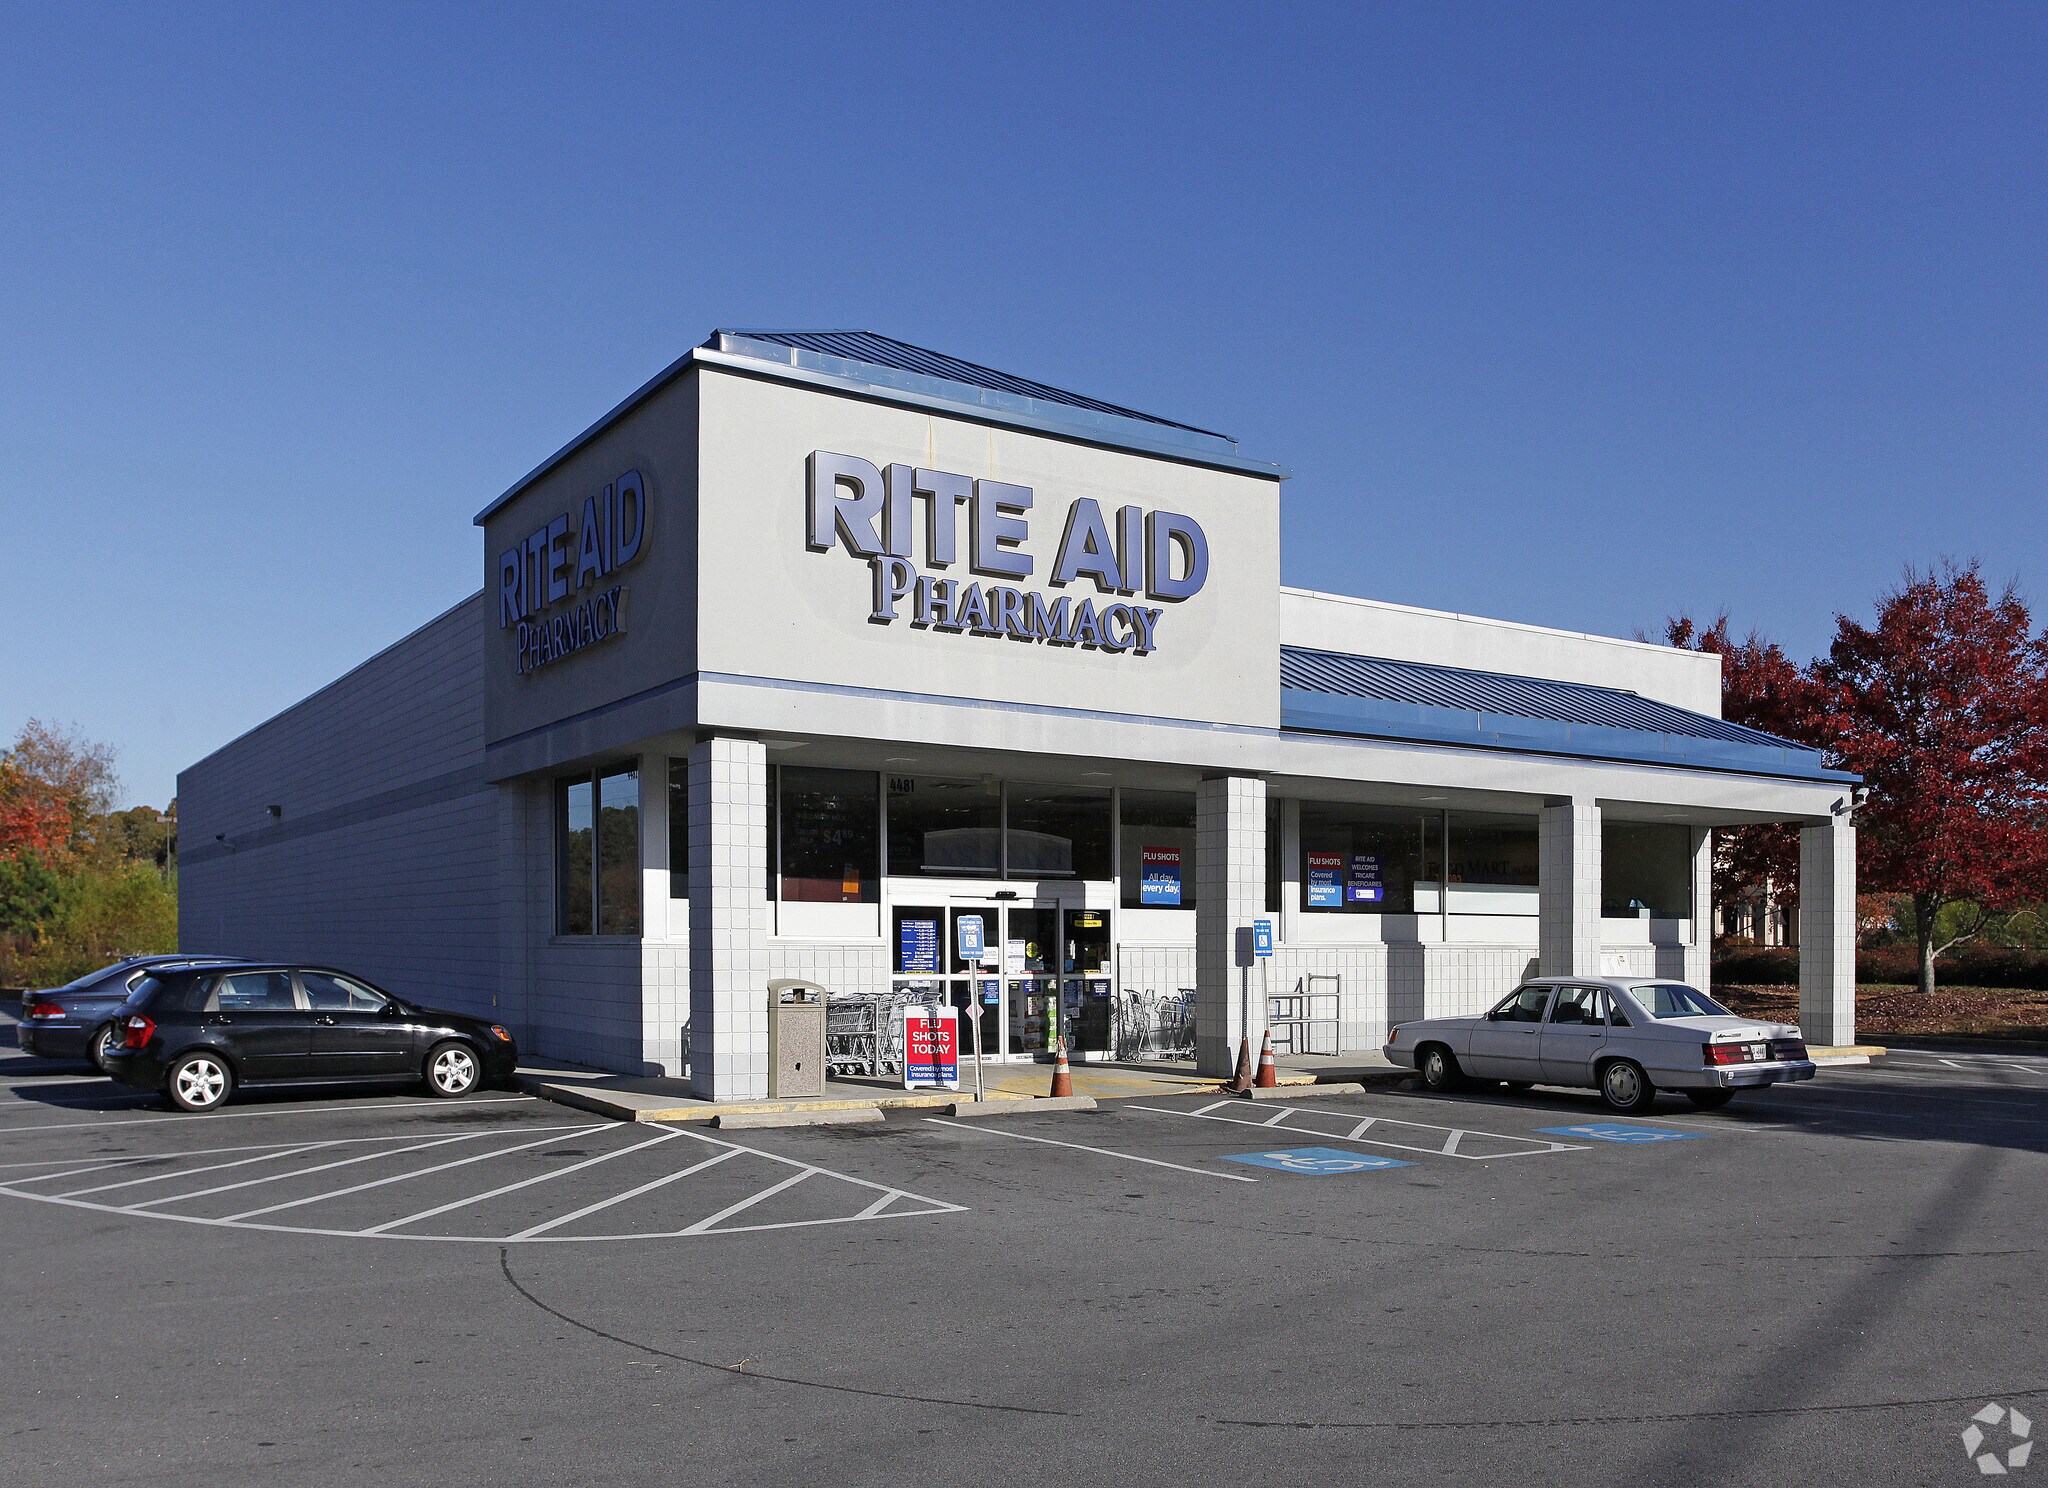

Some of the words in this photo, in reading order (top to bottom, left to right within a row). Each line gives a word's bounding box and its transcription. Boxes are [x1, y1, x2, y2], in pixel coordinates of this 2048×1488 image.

[806, 450, 1033, 580] RITE
[1050, 496, 1209, 602] AID
[499, 512, 574, 629] RITE
[576, 469, 650, 589] AID
[869, 555, 1163, 656] PHARMACY
[516, 586, 626, 675] PHARMACY
[890, 778, 914, 792] 4481
[1143, 852, 1157, 860] FLU
[1157, 853, 1180, 861] SHOTS
[1309, 857, 1321, 865] FLU
[1321, 858, 1341, 866] SHOTS
[1148, 873, 1159, 882] All
[1160, 873, 1175, 884] day,
[1310, 871, 1333, 879] Covered
[1310, 879, 1318, 887] by
[1347, 880, 1383, 888] BENEFICIARIES
[1142, 884, 1163, 894] every
[1310, 893, 1327, 902] plans.
[920, 1019, 942, 1029] FLU
[912, 1031, 950, 1042] SHOTS
[912, 1044, 951, 1055] TODAY
